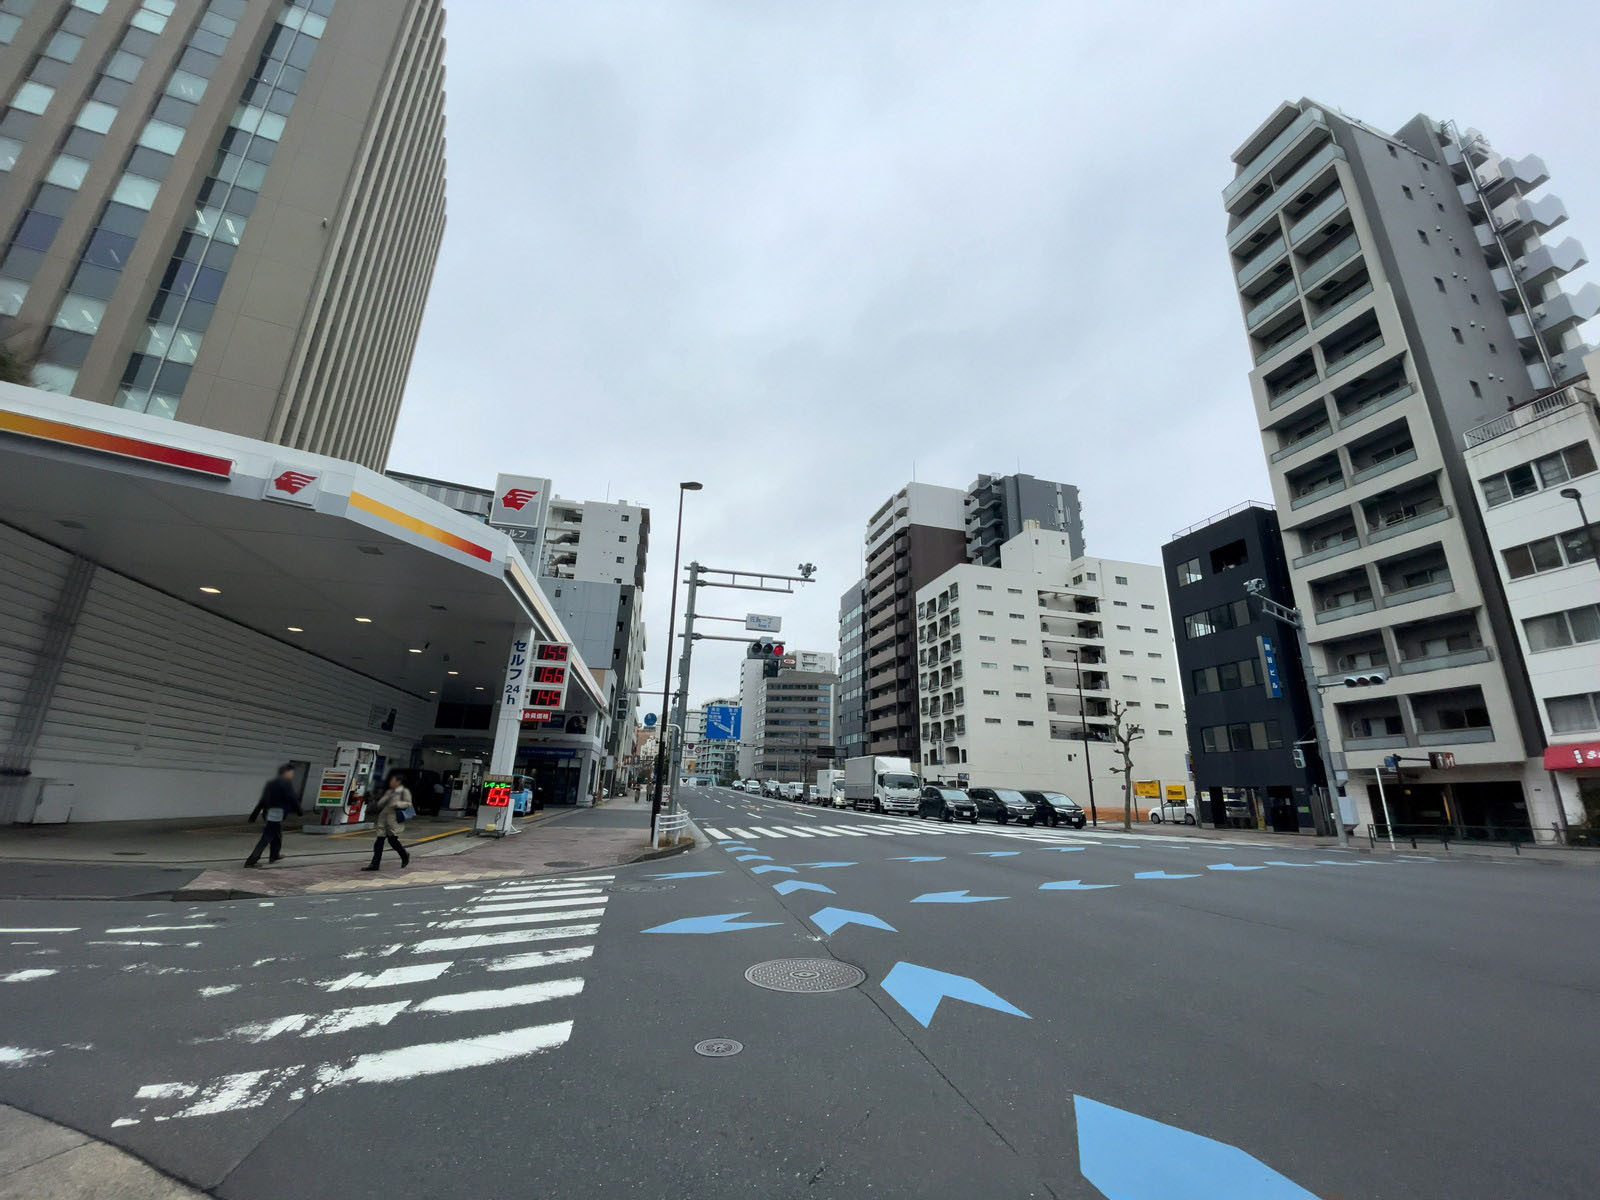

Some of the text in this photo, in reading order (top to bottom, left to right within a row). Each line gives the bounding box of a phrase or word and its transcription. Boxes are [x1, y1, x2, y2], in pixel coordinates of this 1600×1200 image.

[543, 645, 568, 661] 155
[539, 667, 564, 684] 166
[535, 690, 561, 706] 145
